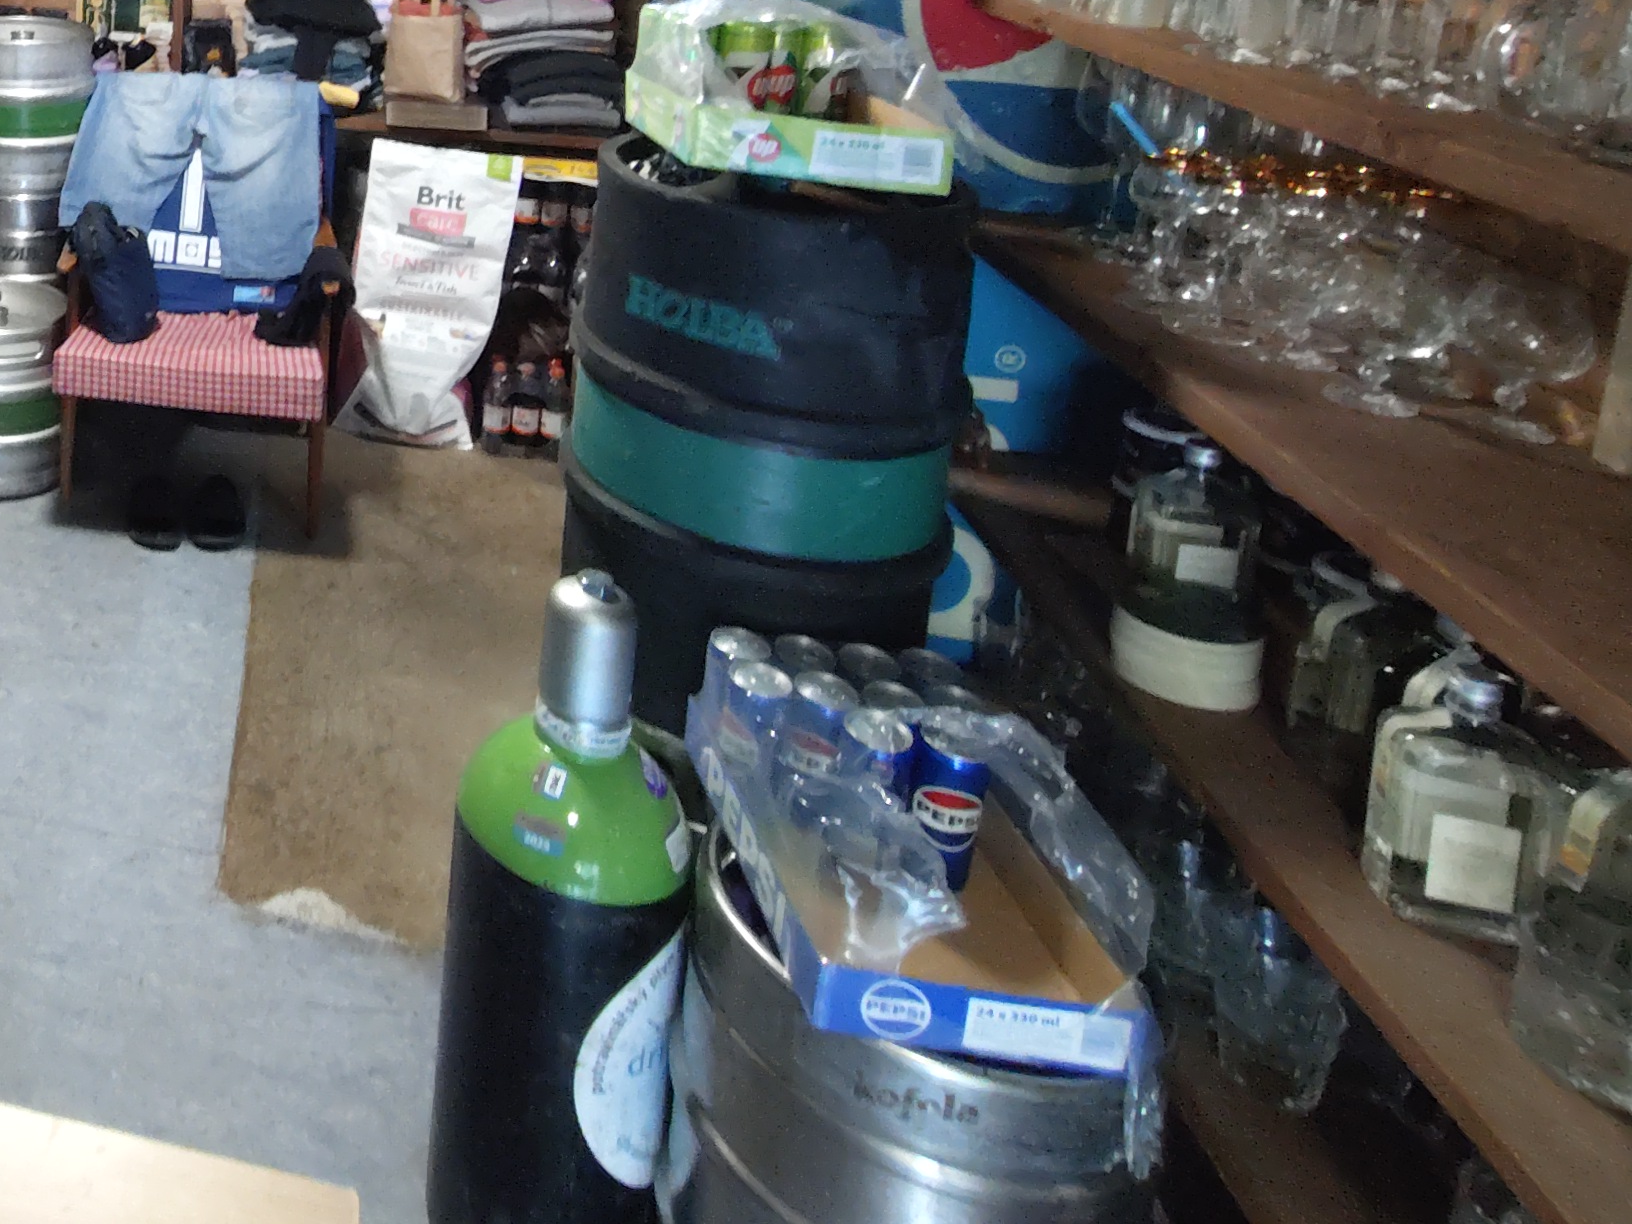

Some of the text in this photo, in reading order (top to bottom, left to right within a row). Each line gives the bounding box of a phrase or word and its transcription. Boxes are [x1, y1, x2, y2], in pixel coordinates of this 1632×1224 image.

[416, 186, 466, 211] Brit
[380, 251, 479, 281] SENSITIVE
[624, 272, 782, 362] HOLBA
[915, 798, 982, 830] PEPSI
[865, 998, 927, 1023] PEPSI
